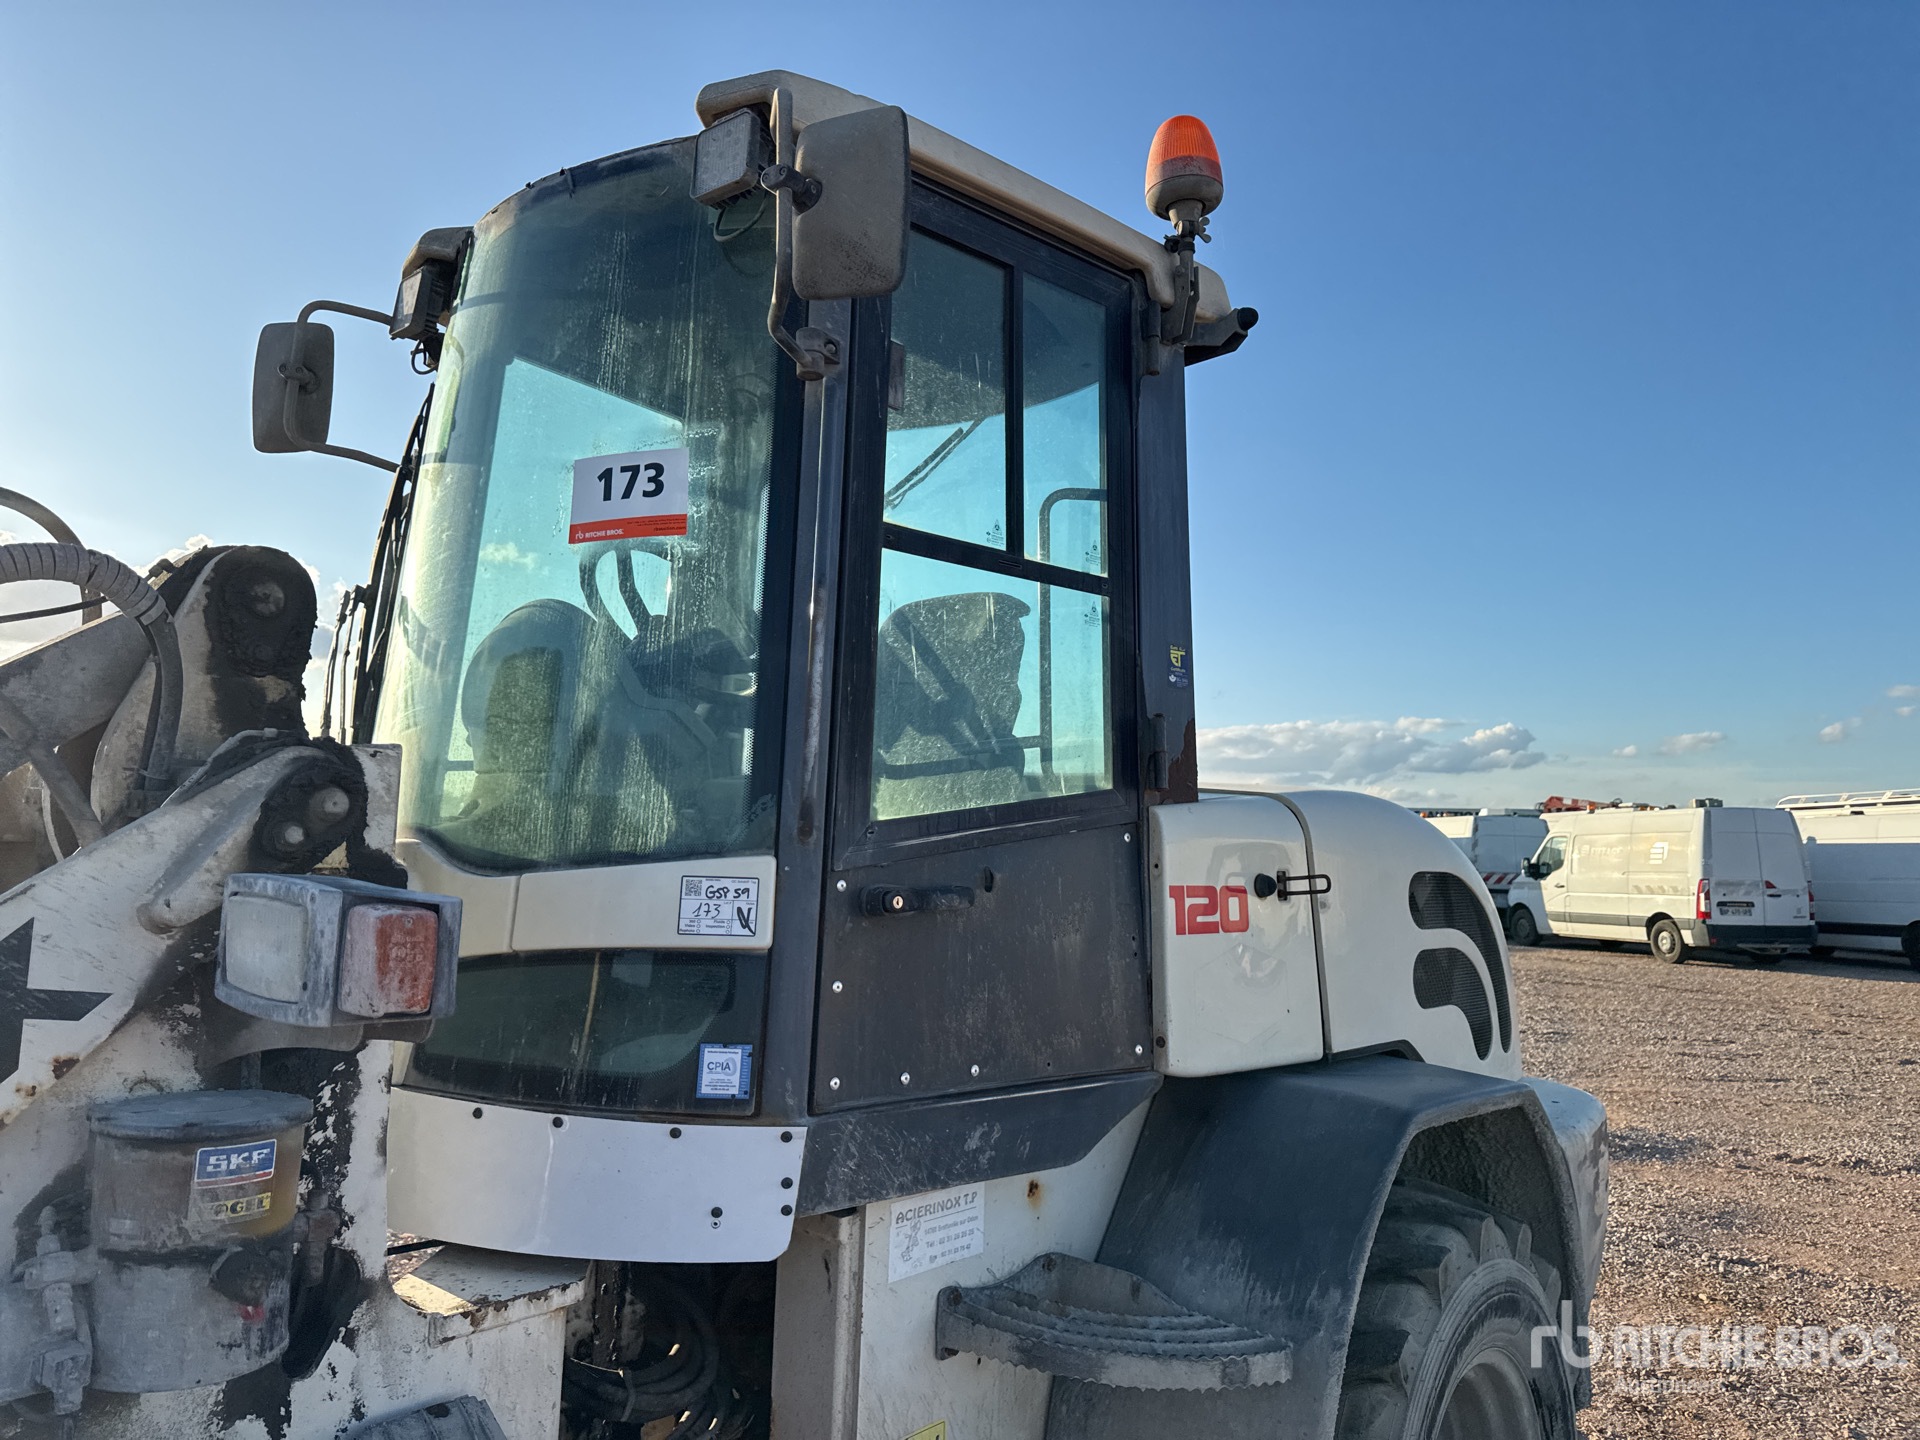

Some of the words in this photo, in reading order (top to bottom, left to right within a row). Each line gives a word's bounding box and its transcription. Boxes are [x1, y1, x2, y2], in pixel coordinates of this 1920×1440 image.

[597, 462, 665, 502] 173
[585, 529, 606, 539] RITCHIE
[692, 902, 721, 919] 173
[1169, 885, 1249, 935] 120
[707, 1061, 731, 1071] CPIA
[206, 1148, 271, 1172] SKF
[895, 1195, 961, 1225] ACIERINOX
